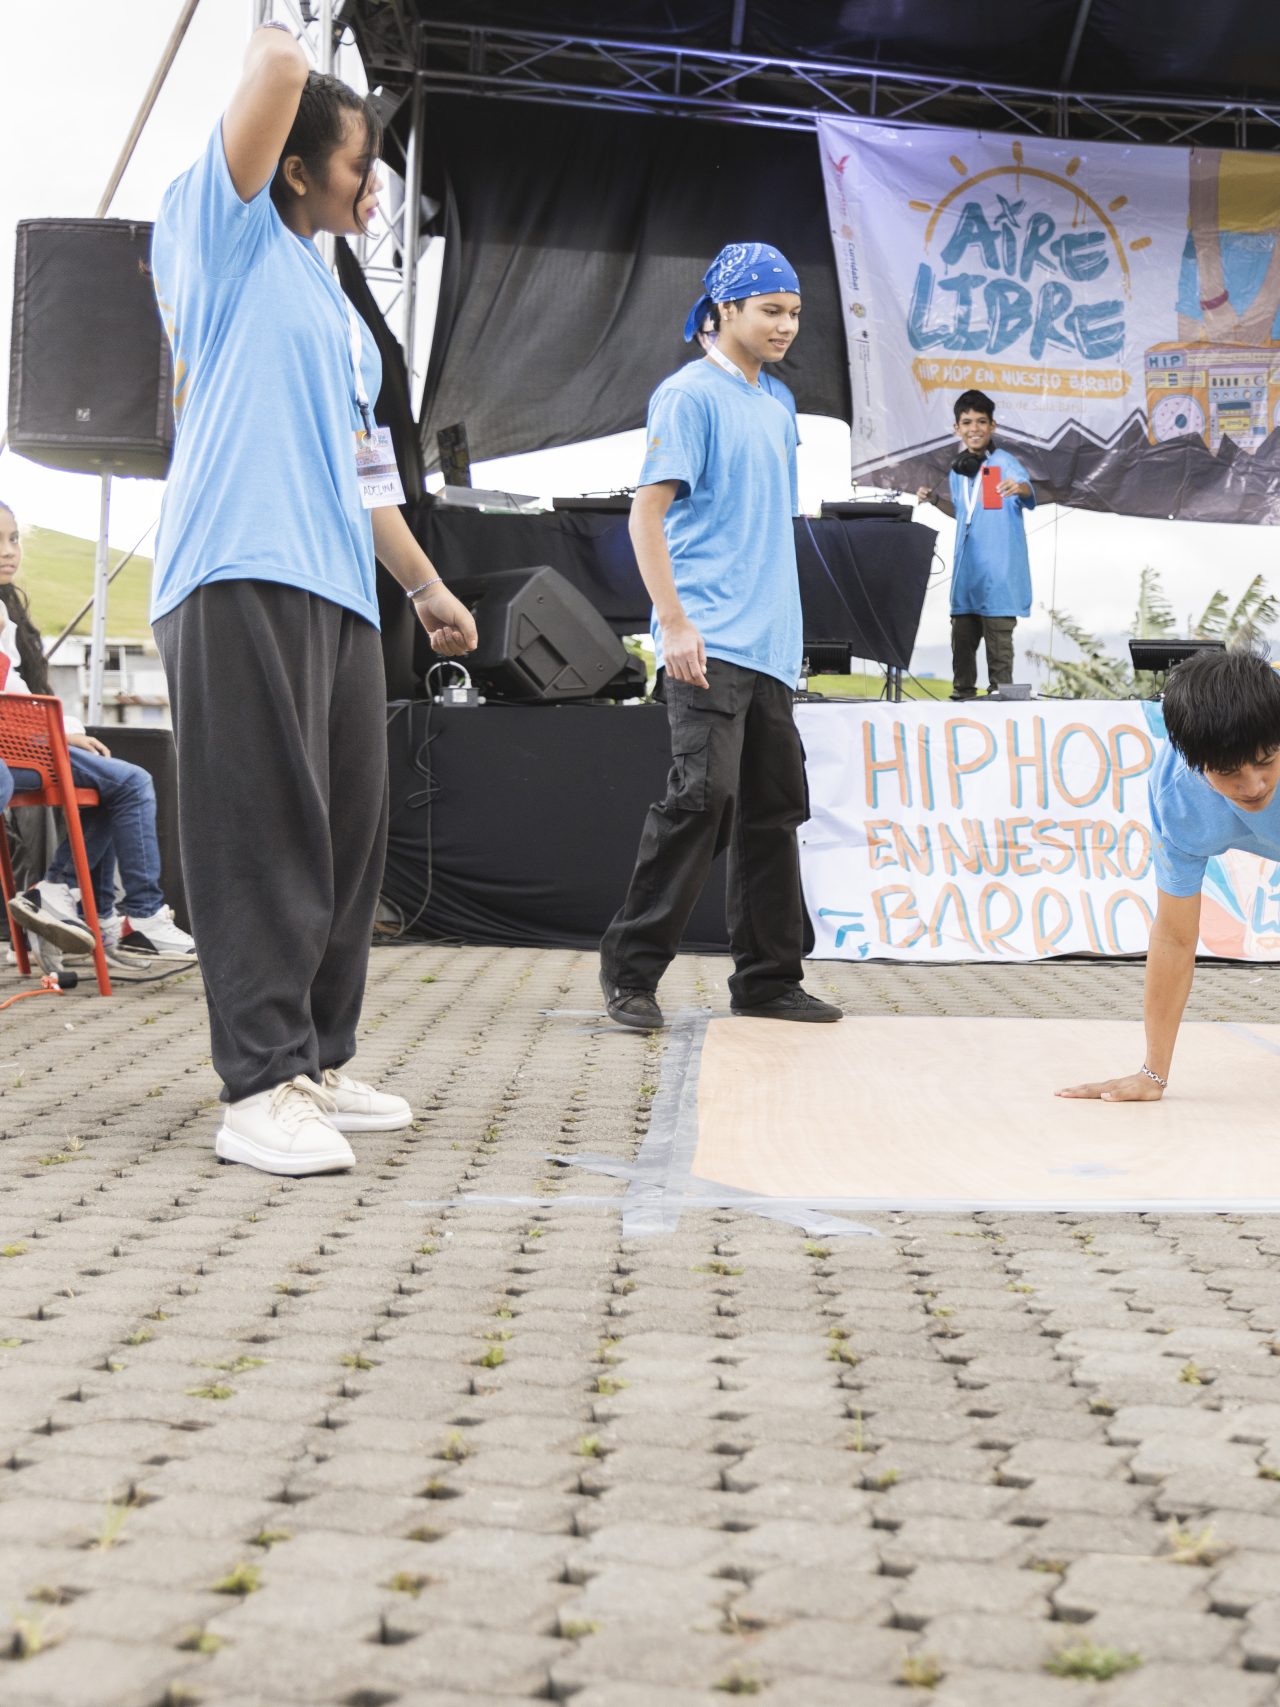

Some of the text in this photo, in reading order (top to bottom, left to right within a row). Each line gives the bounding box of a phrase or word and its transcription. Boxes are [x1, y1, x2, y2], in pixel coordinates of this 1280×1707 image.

[848, 242, 860, 291] Curridabat
[907, 262, 1126, 361] LIBRE
[919, 363, 1124, 392] HIP HOP EN NUESTRO BARRIO
[1149, 355, 1181, 368] HIP
[862, 714, 1156, 813] HIP HOP
[864, 817, 1153, 881] EN NUESTRO
